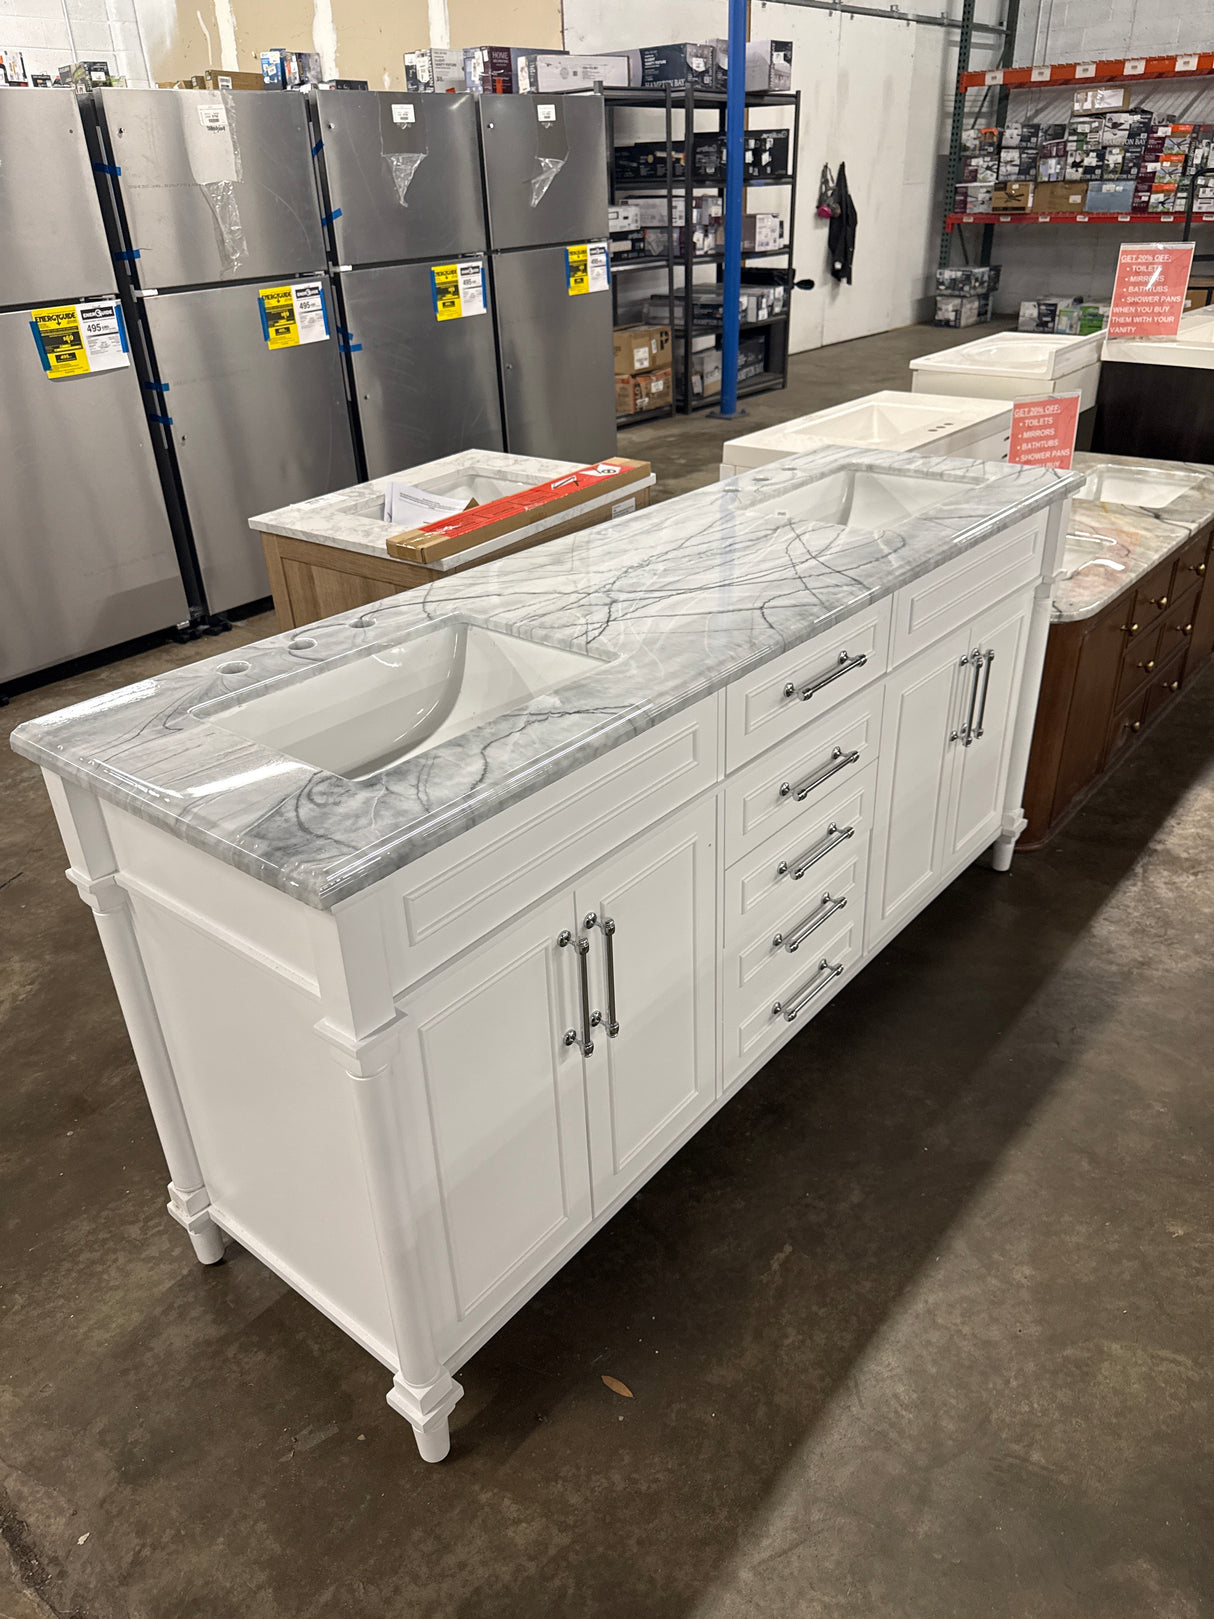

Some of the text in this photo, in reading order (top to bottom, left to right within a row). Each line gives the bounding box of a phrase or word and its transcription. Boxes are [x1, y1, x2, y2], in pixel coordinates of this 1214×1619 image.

[492, 51, 509, 59] HOME
[1160, 295, 1181, 303] PANS
[299, 301, 311, 310] 495
[87, 323, 102, 333] 495
[1014, 408, 1030, 418] GET
[1025, 417, 1053, 427] TOILETS
[1023, 428, 1055, 438] MIRRORS
[1021, 439, 1058, 450] BATHTUBS
[1020, 448, 1070, 461] SHOWER PANS
